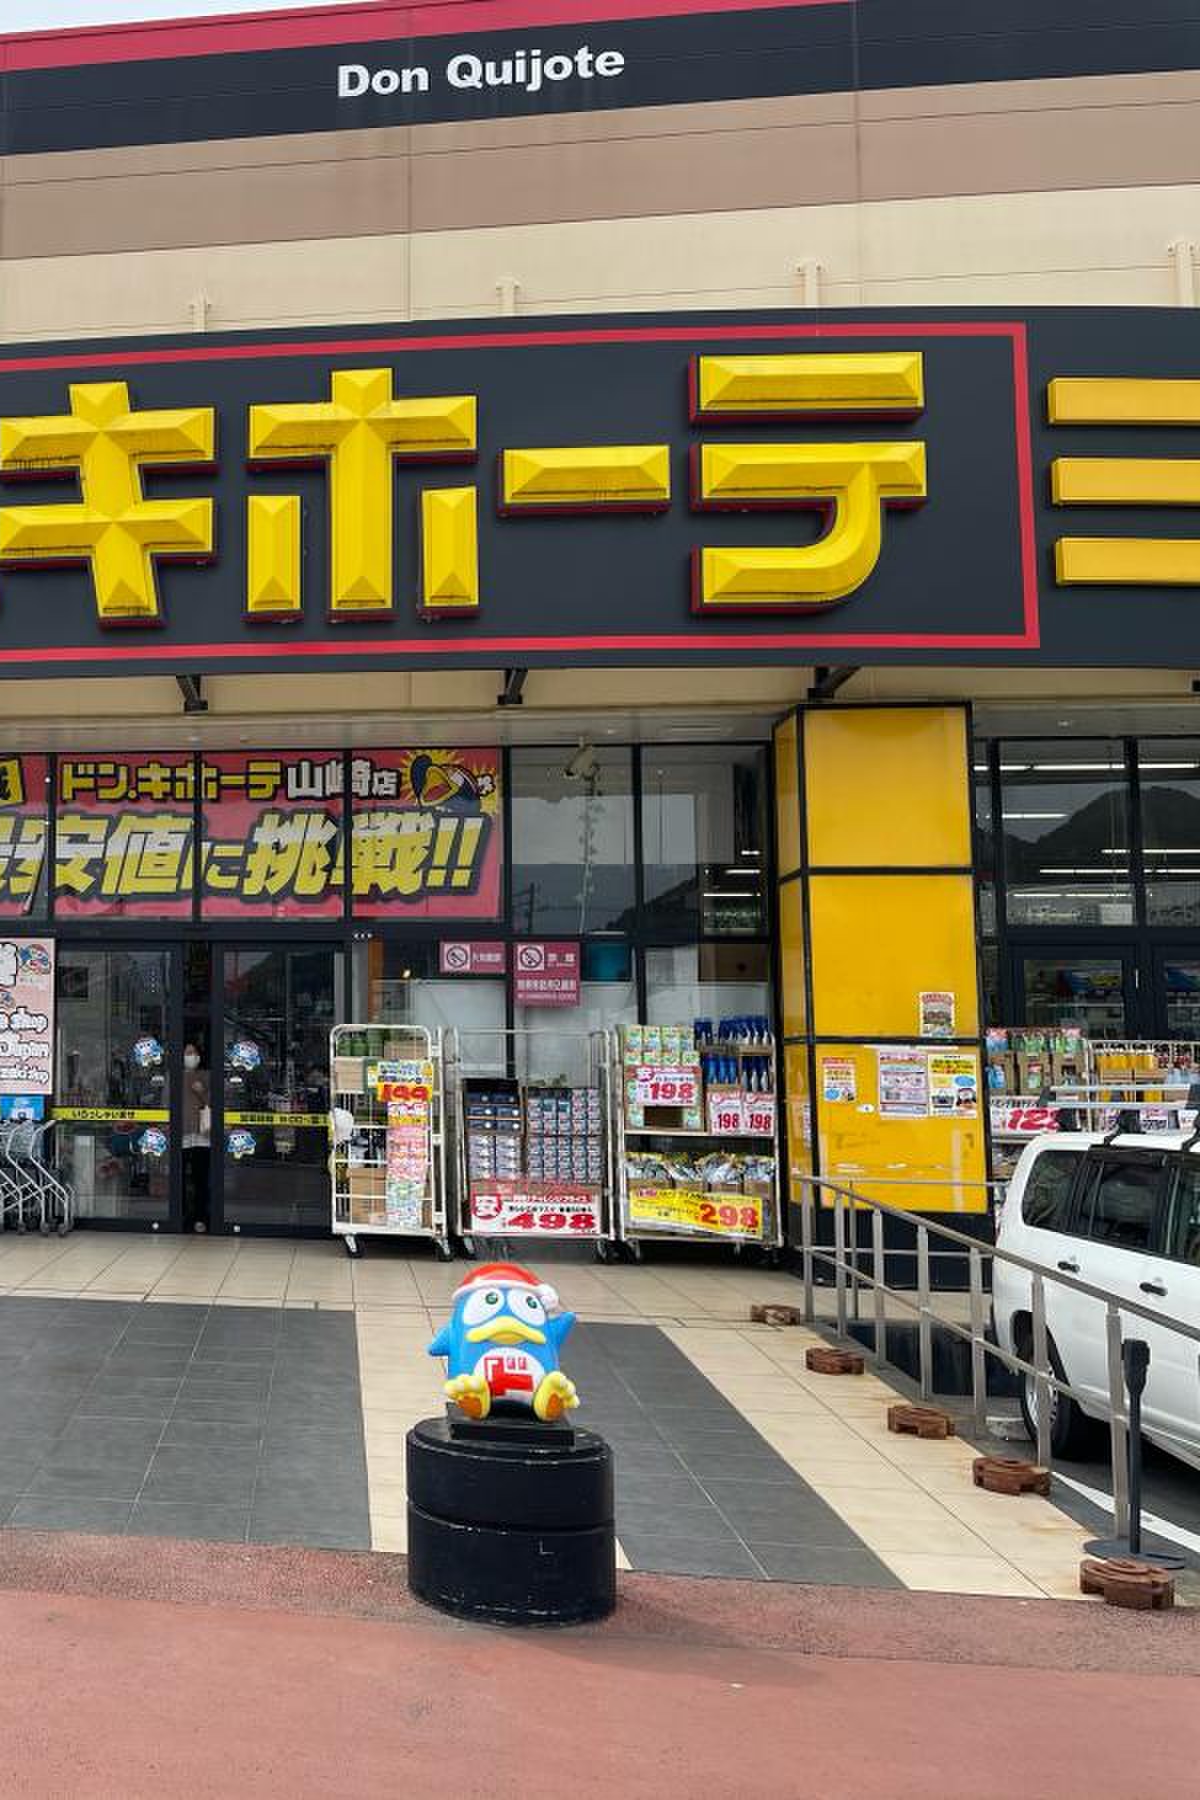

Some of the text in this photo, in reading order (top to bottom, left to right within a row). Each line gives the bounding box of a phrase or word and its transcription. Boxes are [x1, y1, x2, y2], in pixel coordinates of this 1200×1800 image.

[338, 45, 625, 98] Don Quijote
[650, 1082, 694, 1100] 198
[717, 1113, 740, 1129] 198
[750, 1113, 773, 1130] 198
[507, 1211, 595, 1230] 498
[700, 1203, 759, 1228] 298
